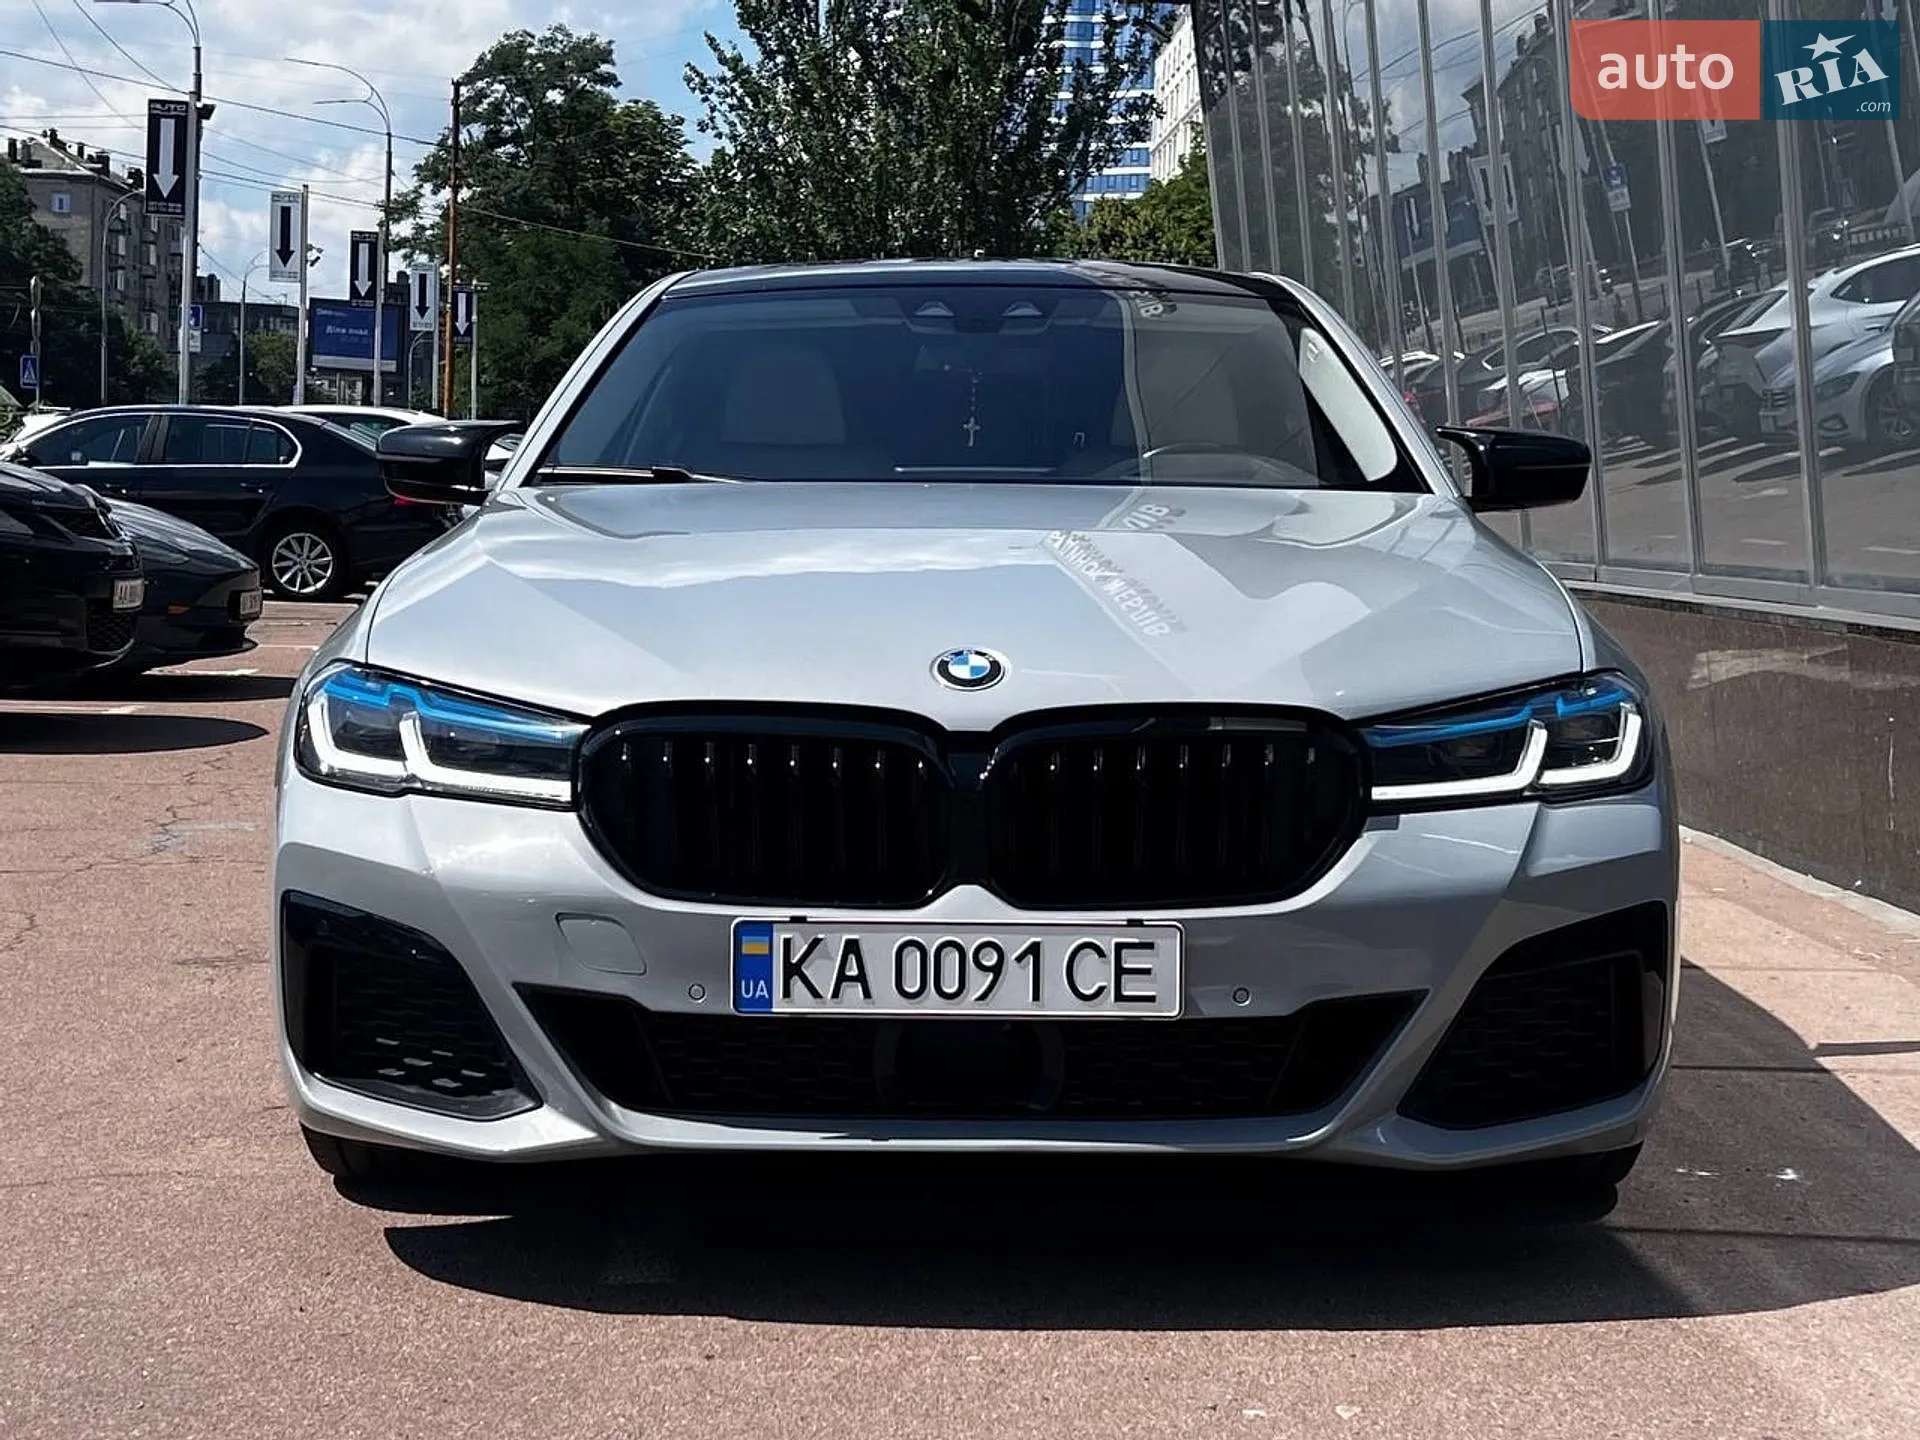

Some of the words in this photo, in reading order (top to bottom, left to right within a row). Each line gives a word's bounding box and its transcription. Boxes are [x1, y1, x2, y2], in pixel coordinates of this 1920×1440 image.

[741, 980, 769, 999] UA
[781, 936, 873, 1001] KA
[892, 937, 1042, 1003] 0091
[1064, 938, 1157, 1004] CE
